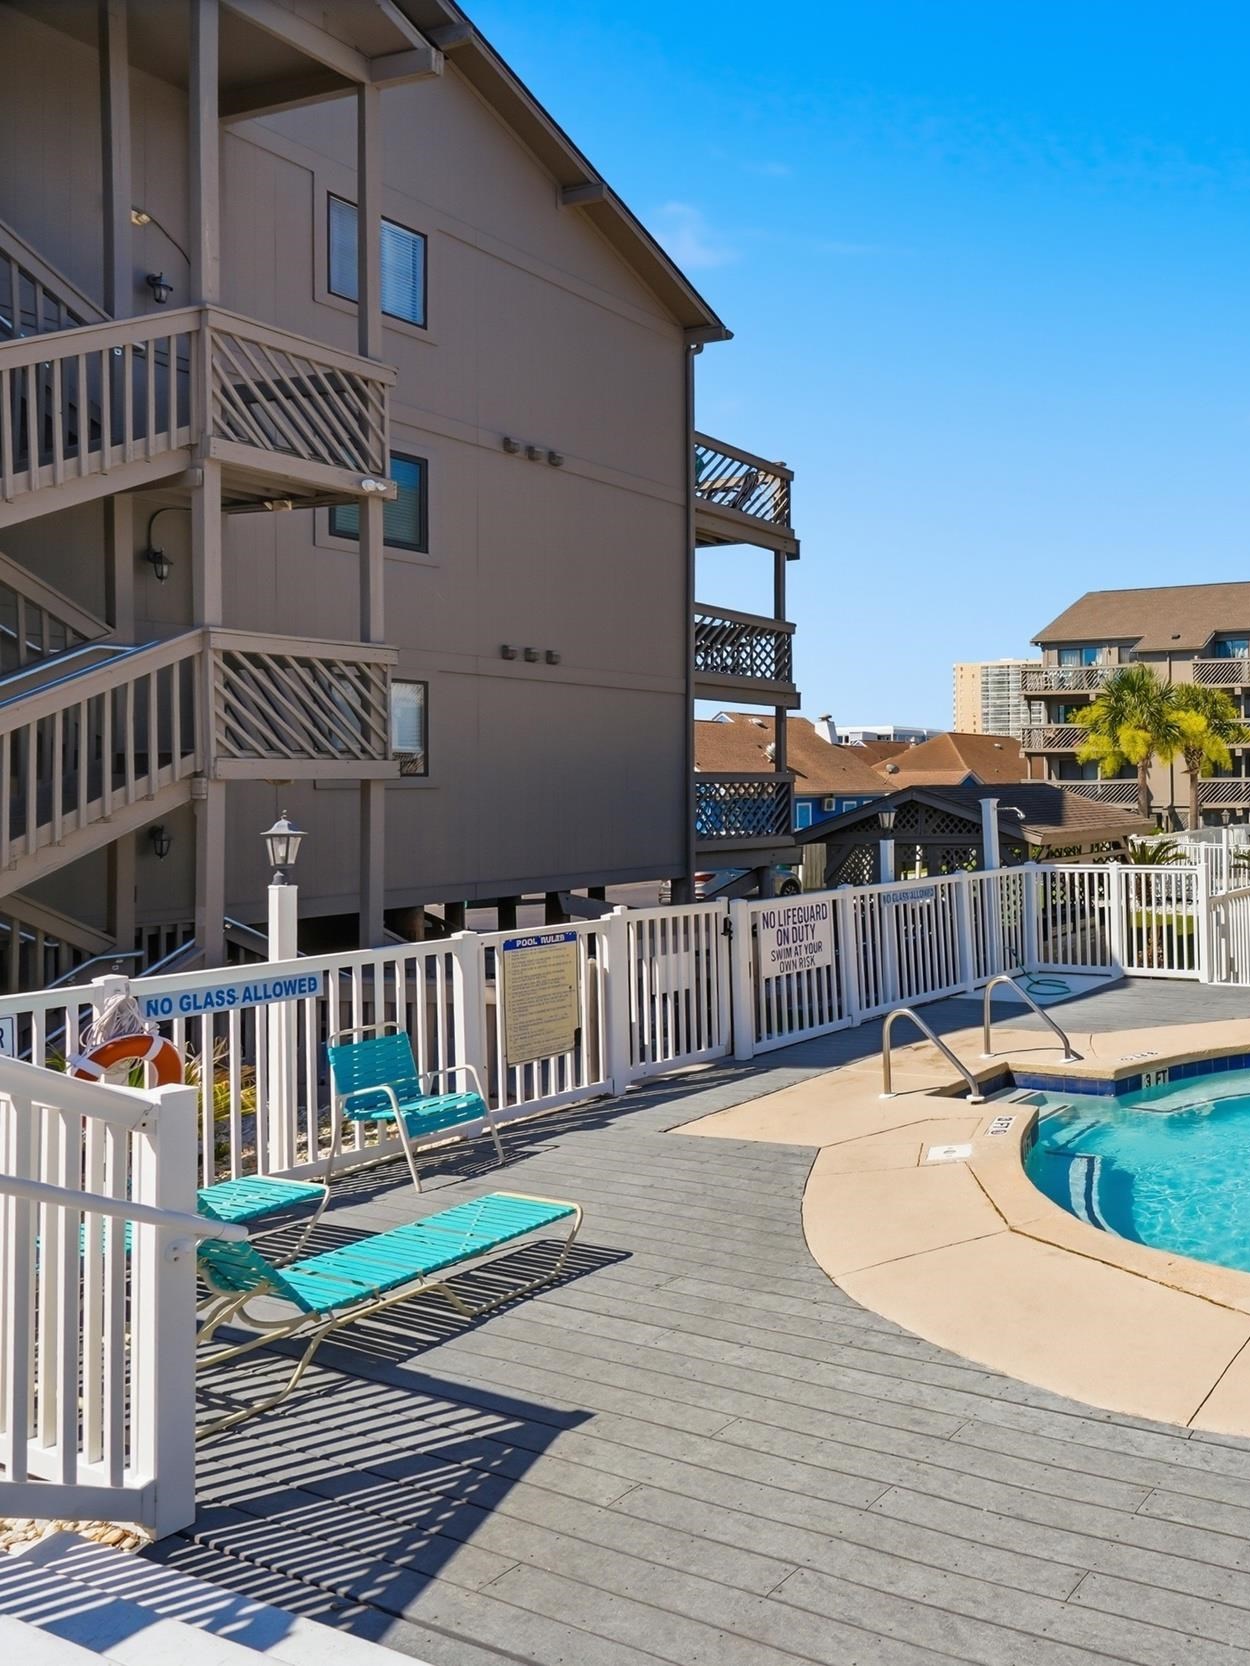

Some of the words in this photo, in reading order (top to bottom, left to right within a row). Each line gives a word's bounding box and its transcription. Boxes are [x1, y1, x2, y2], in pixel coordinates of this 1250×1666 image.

[762, 910, 776, 930] NO
[778, 903, 829, 927] LIFEGUARD
[515, 938, 538, 948] POOL
[776, 928, 790, 947] ON
[791, 923, 816, 944] DUTY
[770, 947, 792, 962] SWIM
[794, 946, 804, 957] AT
[804, 941, 823, 954] YOUR
[780, 958, 798, 974] OWN
[799, 955, 816, 969] RISK
[146, 996, 173, 1018] NO
[179, 987, 236, 1012] GLASS
[241, 975, 318, 1002] ALLOWED
[1145, 1072, 1152, 1088] 3
[1155, 1069, 1168, 1086] FT
